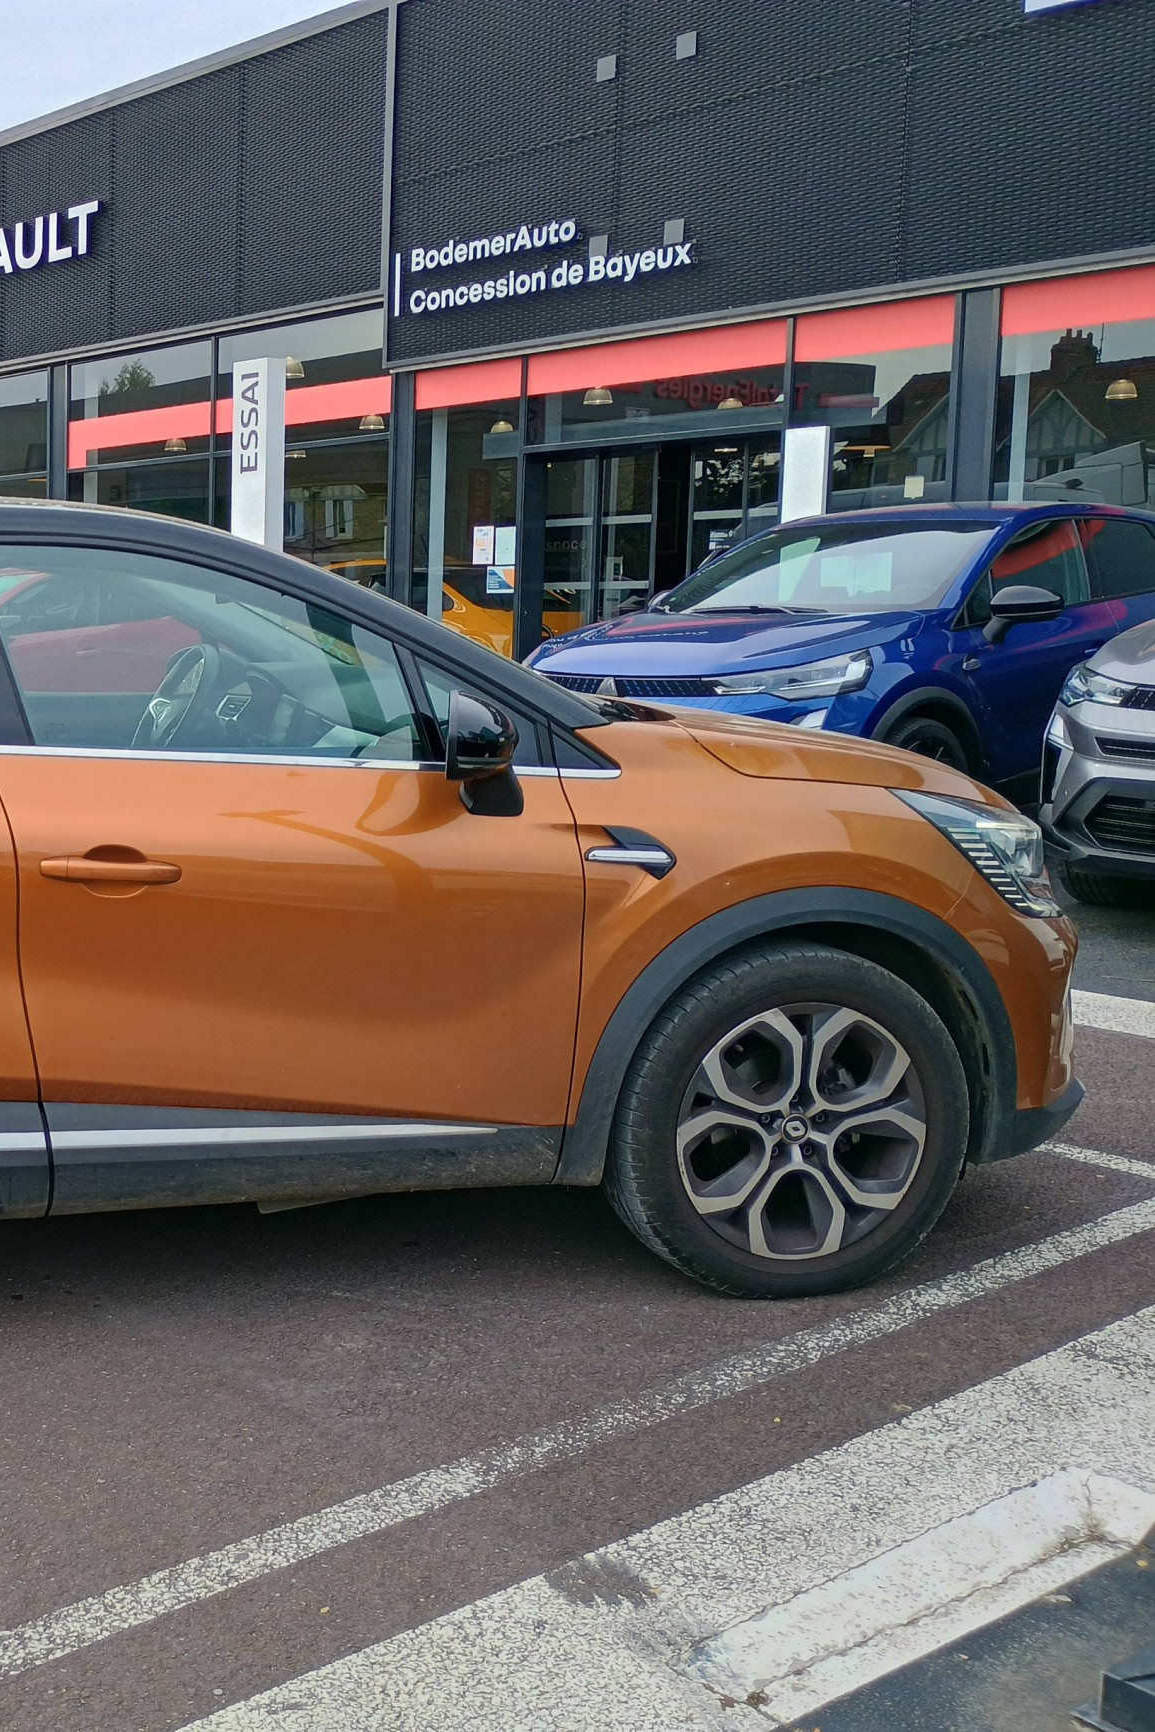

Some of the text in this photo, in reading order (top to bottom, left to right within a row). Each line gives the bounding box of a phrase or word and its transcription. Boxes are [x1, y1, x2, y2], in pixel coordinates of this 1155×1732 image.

[410, 243, 692, 314] Concession de Bayeux
[411, 219, 576, 272] BodemerAuto
[240, 371, 260, 474] ESSAI
